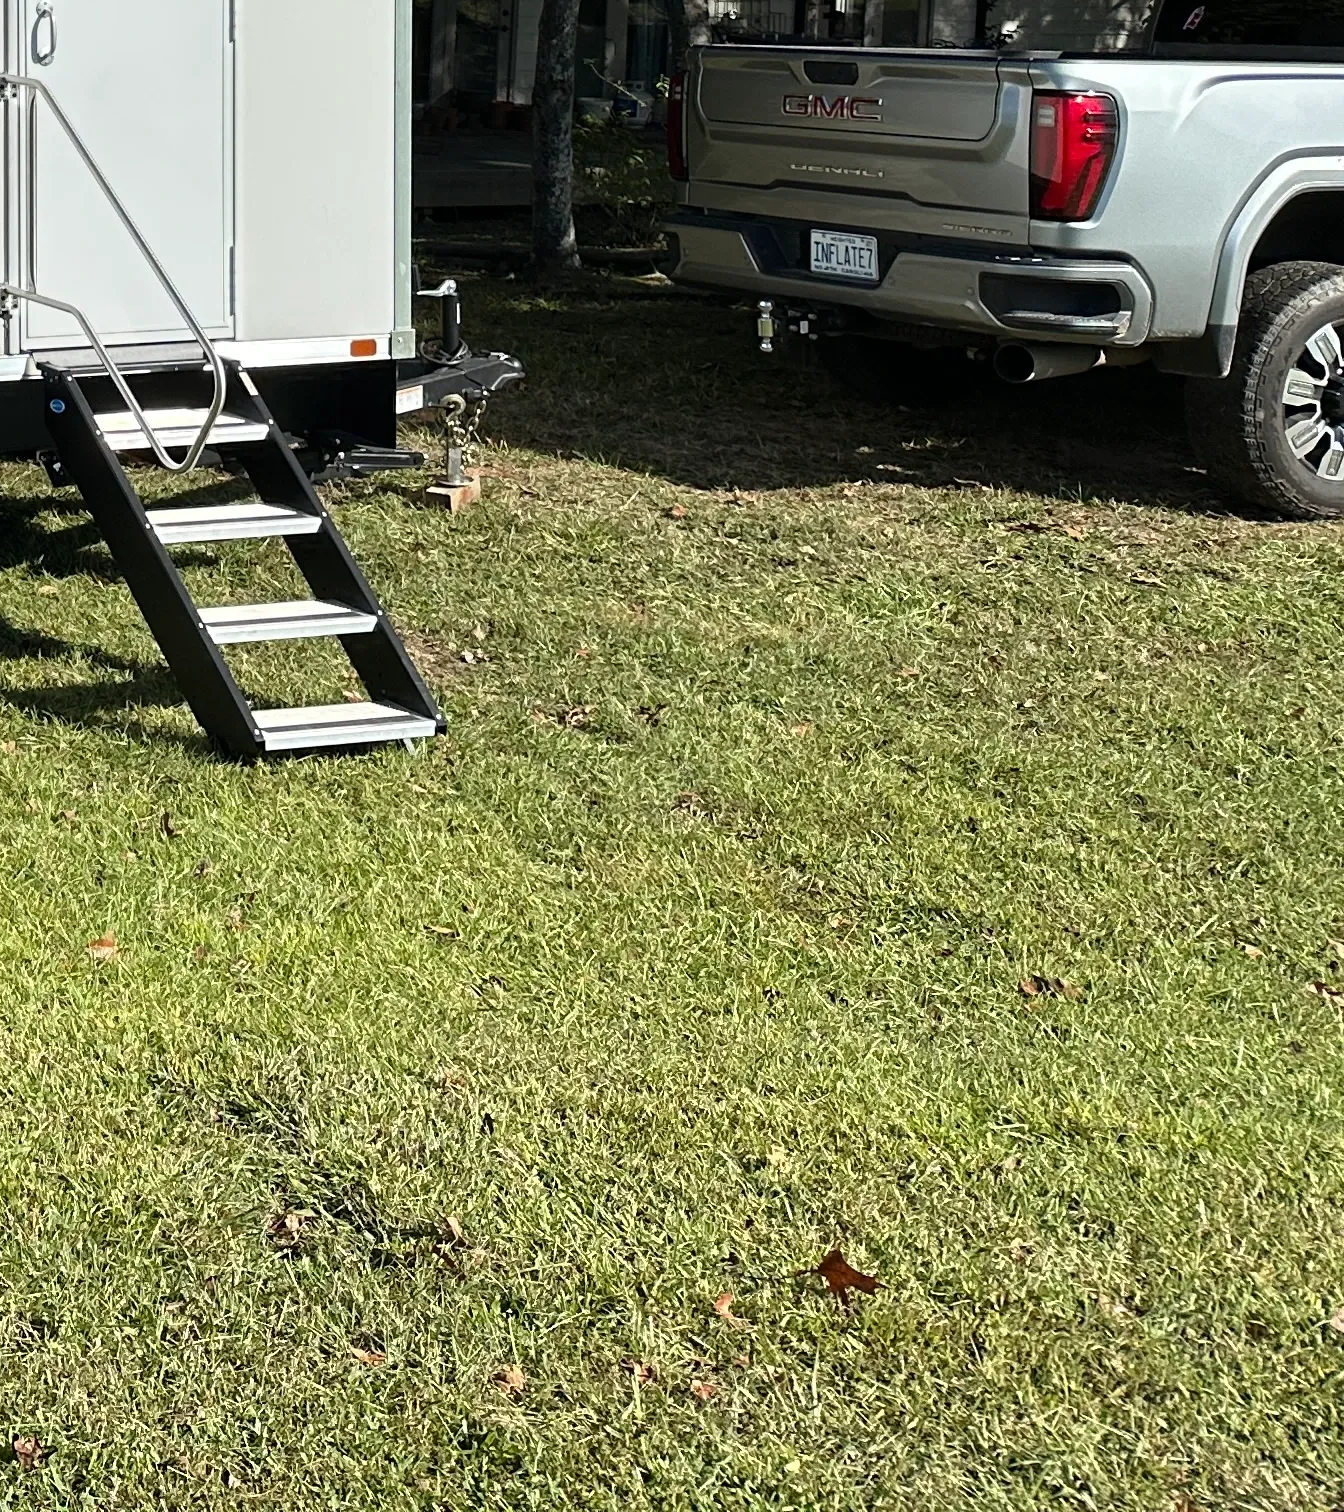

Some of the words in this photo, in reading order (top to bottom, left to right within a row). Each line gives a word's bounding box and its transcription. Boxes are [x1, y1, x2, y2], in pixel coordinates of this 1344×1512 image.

[780, 94, 883, 121] GMC
[790, 161, 885, 178] DENALI
[814, 241, 873, 270] INFLATE7
